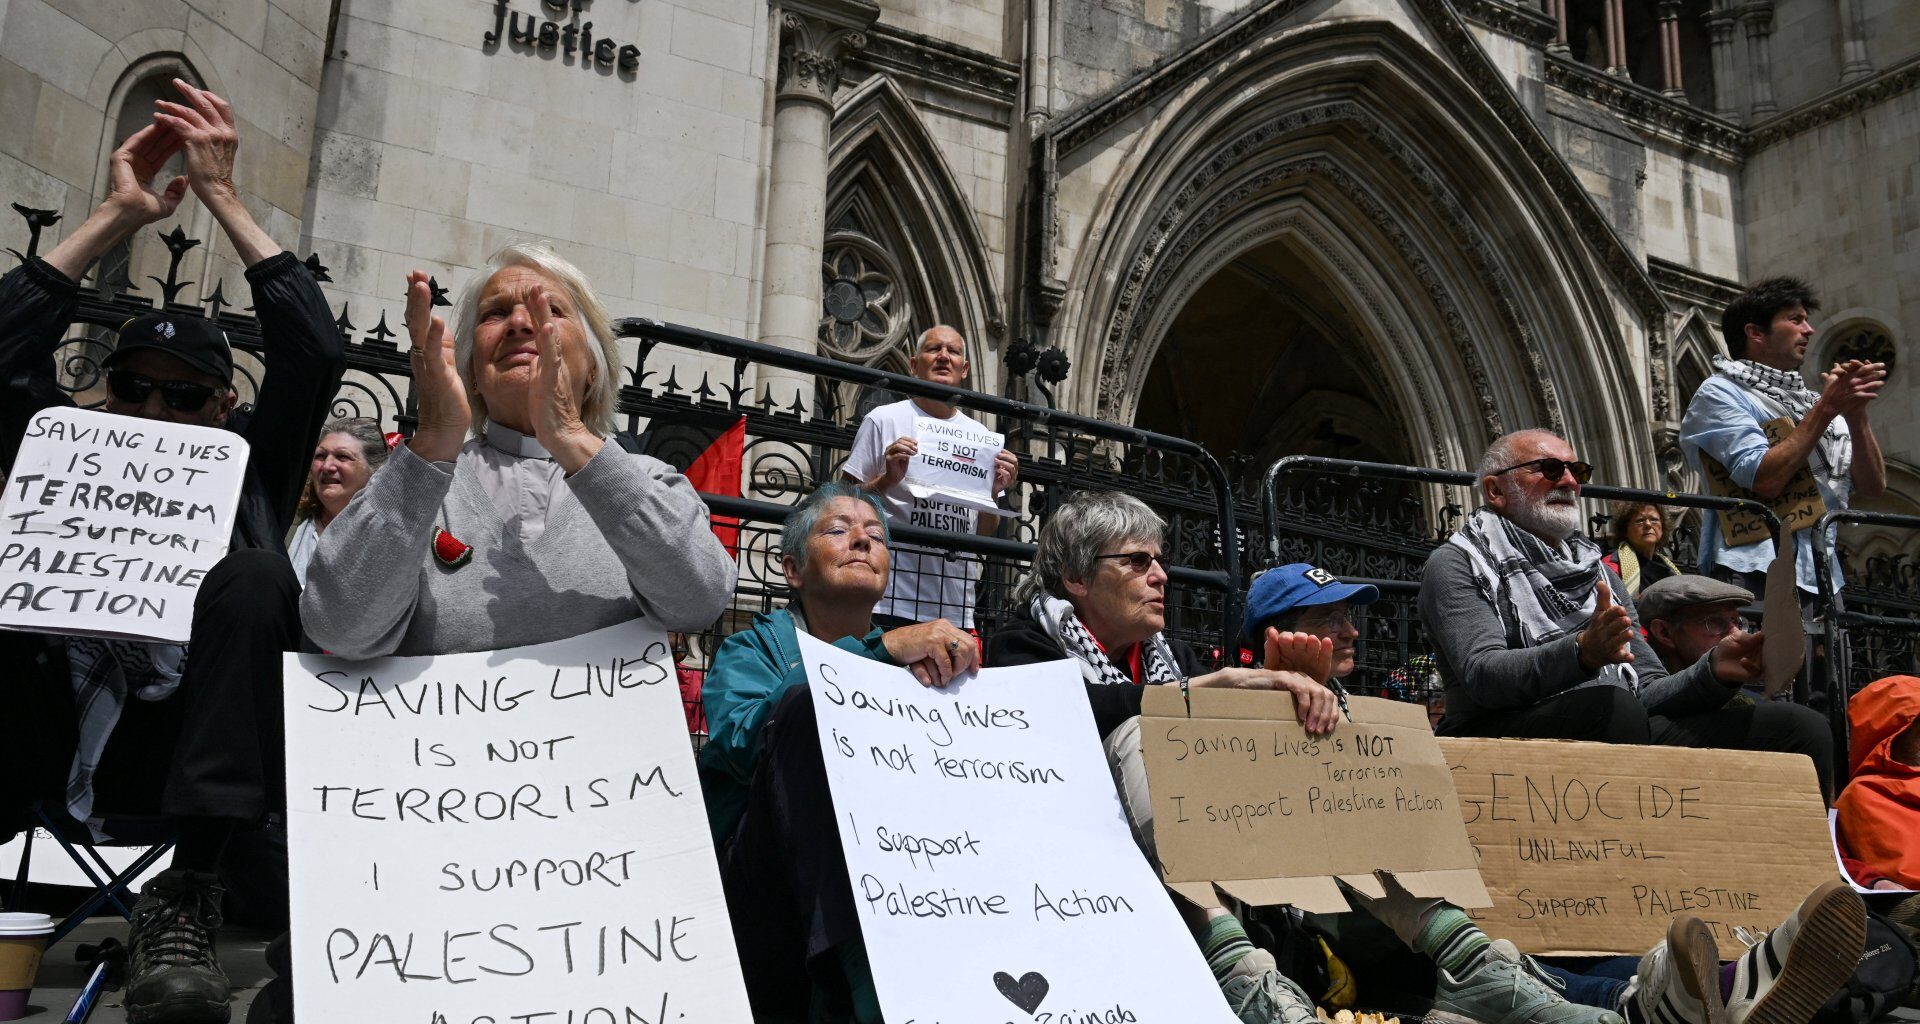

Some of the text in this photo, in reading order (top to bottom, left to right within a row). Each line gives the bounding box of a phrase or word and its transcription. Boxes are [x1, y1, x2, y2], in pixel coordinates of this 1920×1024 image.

[26, 416, 230, 461] SAVING LIVES
[917, 422, 1000, 447] SAVING LIVES
[937, 441, 978, 458] IS NOT
[67, 452, 208, 485] IS NOT
[921, 453, 988, 480] TERRORISM
[15, 474, 215, 524] TERRORISM
[8, 509, 56, 535] I
[910, 511, 970, 534] PALESTINE
[1731, 505, 1813, 538] ACON
[0, 543, 208, 588] PALESTINE
[0, 581, 166, 619] ACTION
[308, 642, 669, 719] SAVING LIVES
[819, 663, 1030, 746] Saving lives
[414, 736, 575, 766] IS NOT
[832, 728, 1064, 784] is not terrorism
[1166, 725, 1257, 761] Saving
[1273, 731, 1320, 757] Lives
[1356, 734, 1394, 757] NOT
[1321, 762, 1403, 783] Terrorism
[313, 766, 683, 824] TERRORISM
[1170, 786, 1443, 833] I support Palestine Action
[849, 812, 981, 872] I support
[1517, 837, 1665, 862] UNLAWFUL
[439, 850, 636, 891] SUPPORT
[860, 873, 1134, 921] Palestine Action
[1516, 884, 1762, 920] SUPPORT PALESTINE
[326, 916, 698, 984] PALESTINE
